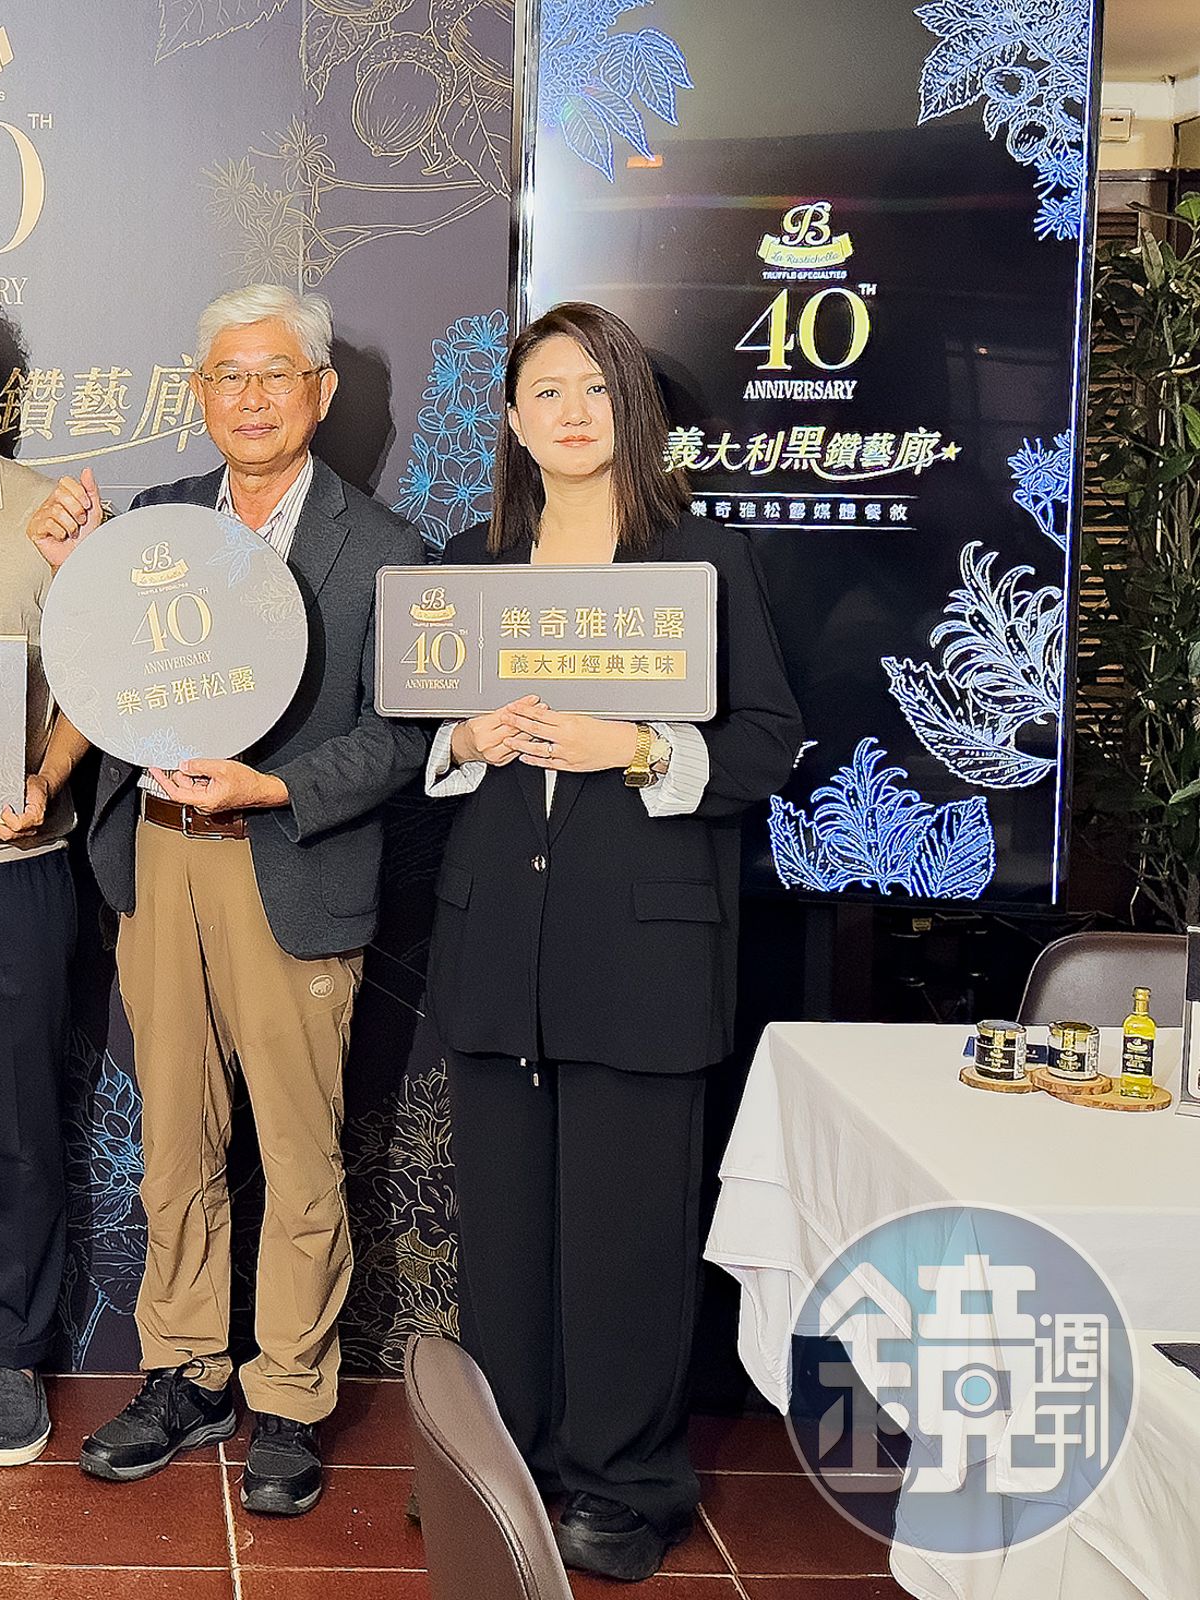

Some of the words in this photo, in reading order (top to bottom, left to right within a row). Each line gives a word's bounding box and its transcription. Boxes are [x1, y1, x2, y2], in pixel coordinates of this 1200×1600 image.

[743, 380, 858, 400] ANNIVERSARY
[663, 426, 943, 480] 義大利黑鑽藝廊
[500, 606, 686, 640] 樂奇雅松露
[143, 650, 213, 675] ANNIVERSARY
[510, 654, 676, 676] 義大利經典美味
[115, 664, 257, 717] 樂奇雅松露
